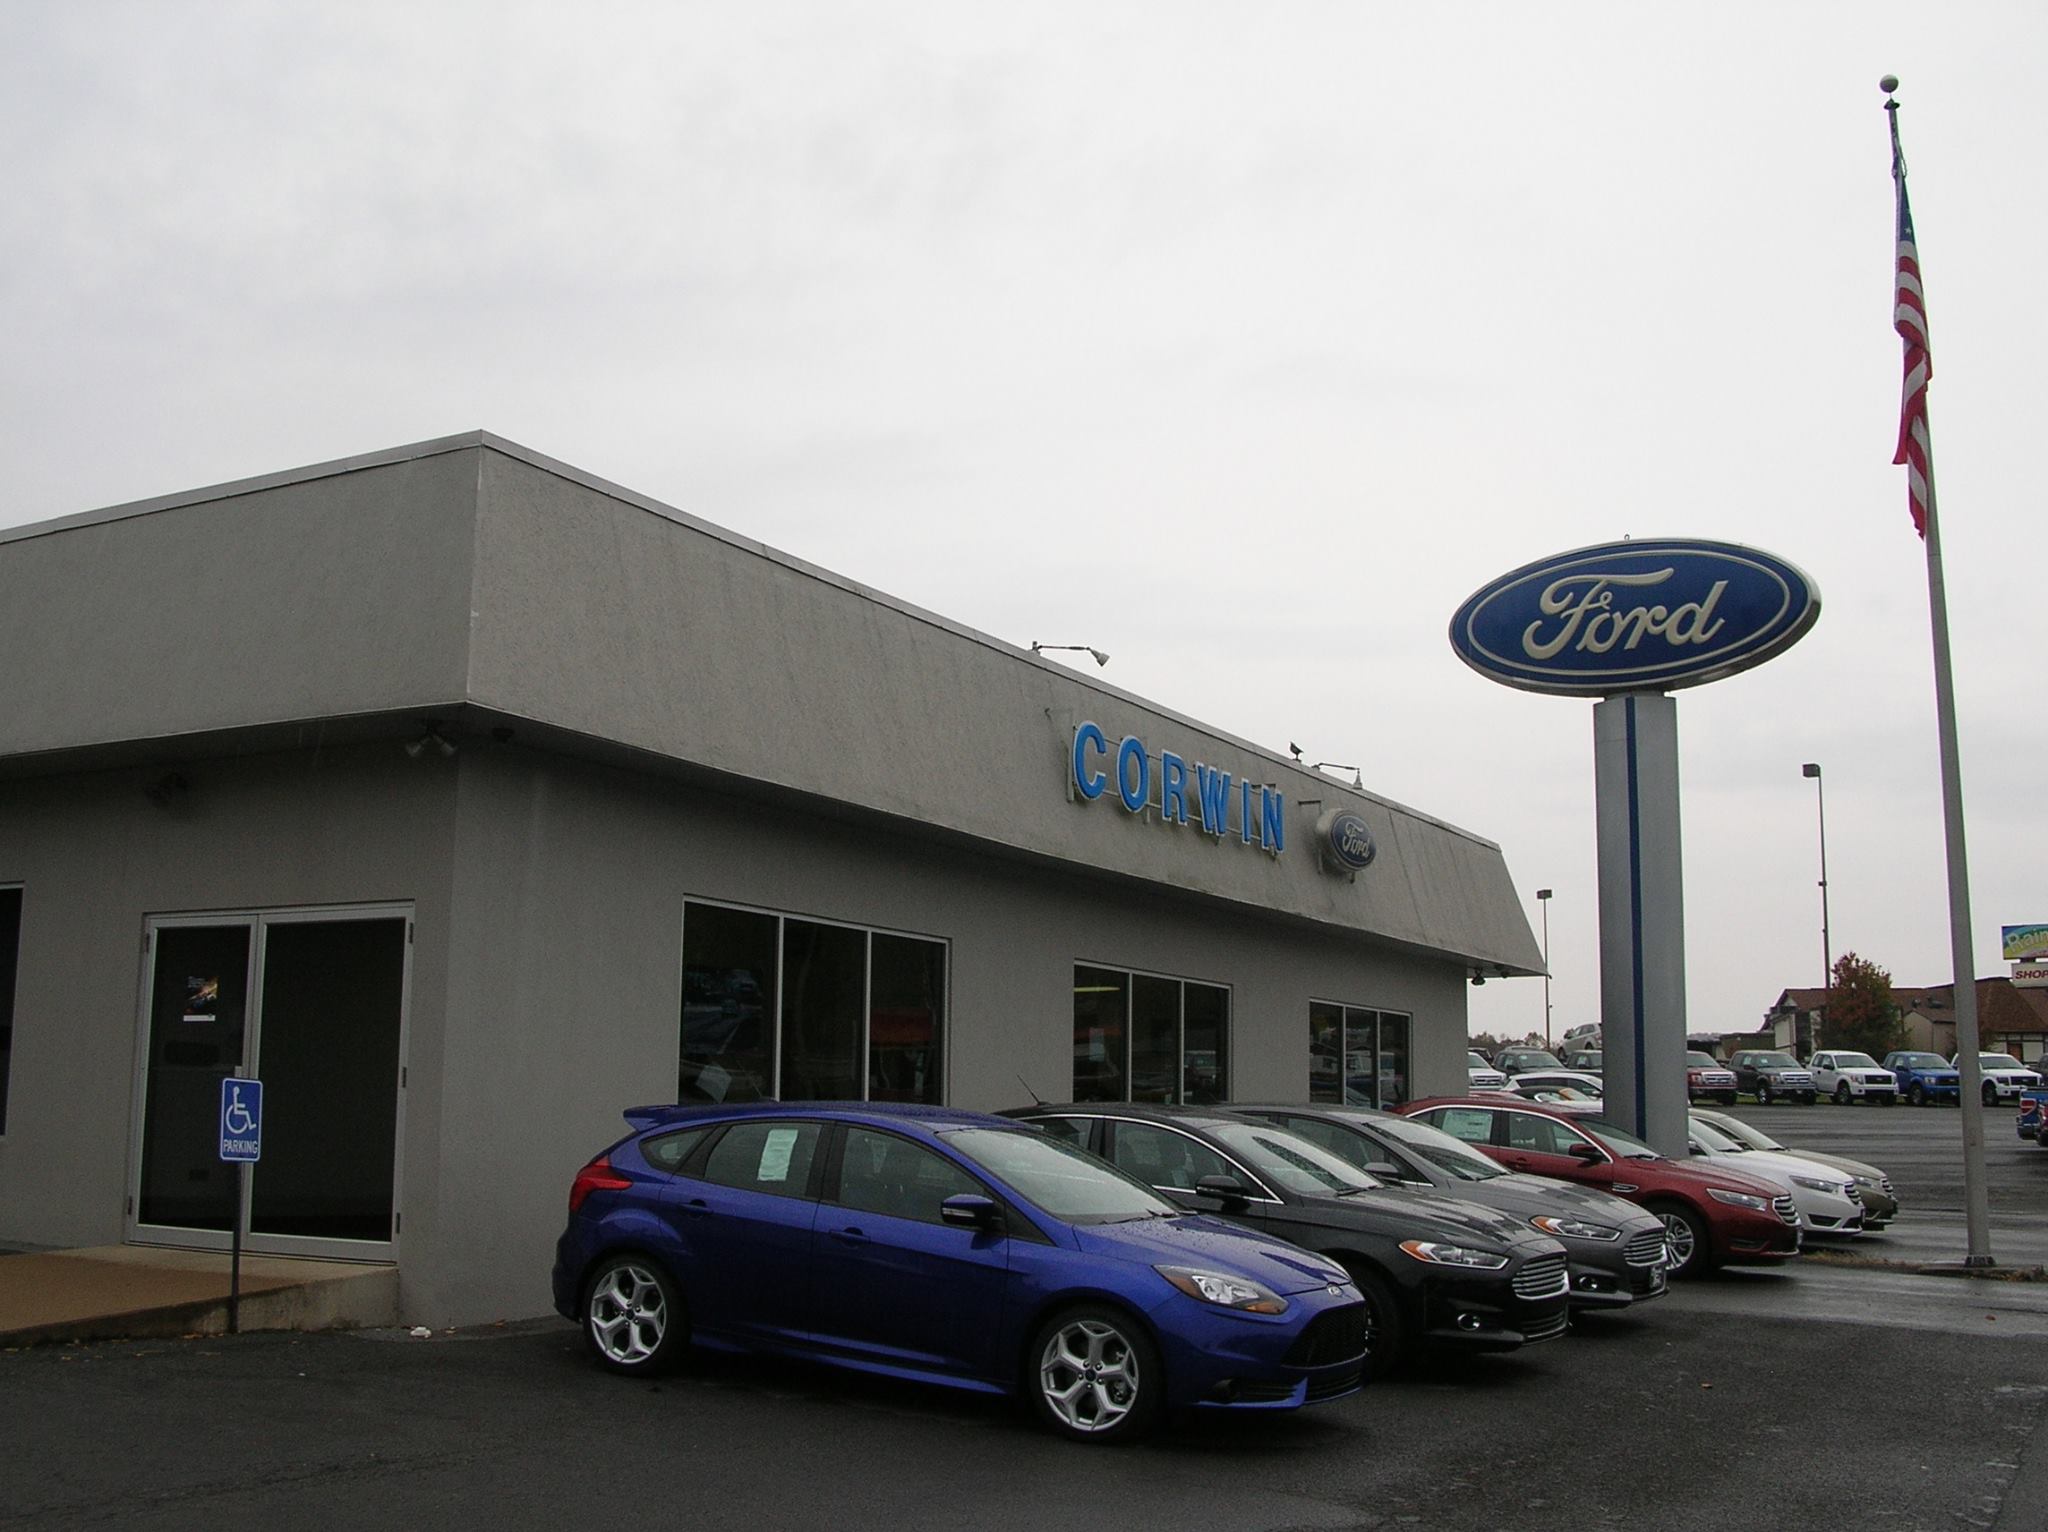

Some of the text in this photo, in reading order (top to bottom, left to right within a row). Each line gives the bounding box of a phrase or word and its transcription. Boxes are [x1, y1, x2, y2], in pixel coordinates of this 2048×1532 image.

[1522, 567, 1729, 659] Ford
[1073, 720, 1284, 854] CORWIN
[1342, 821, 1370, 858] Ford
[223, 1139, 258, 1154] PARKING
